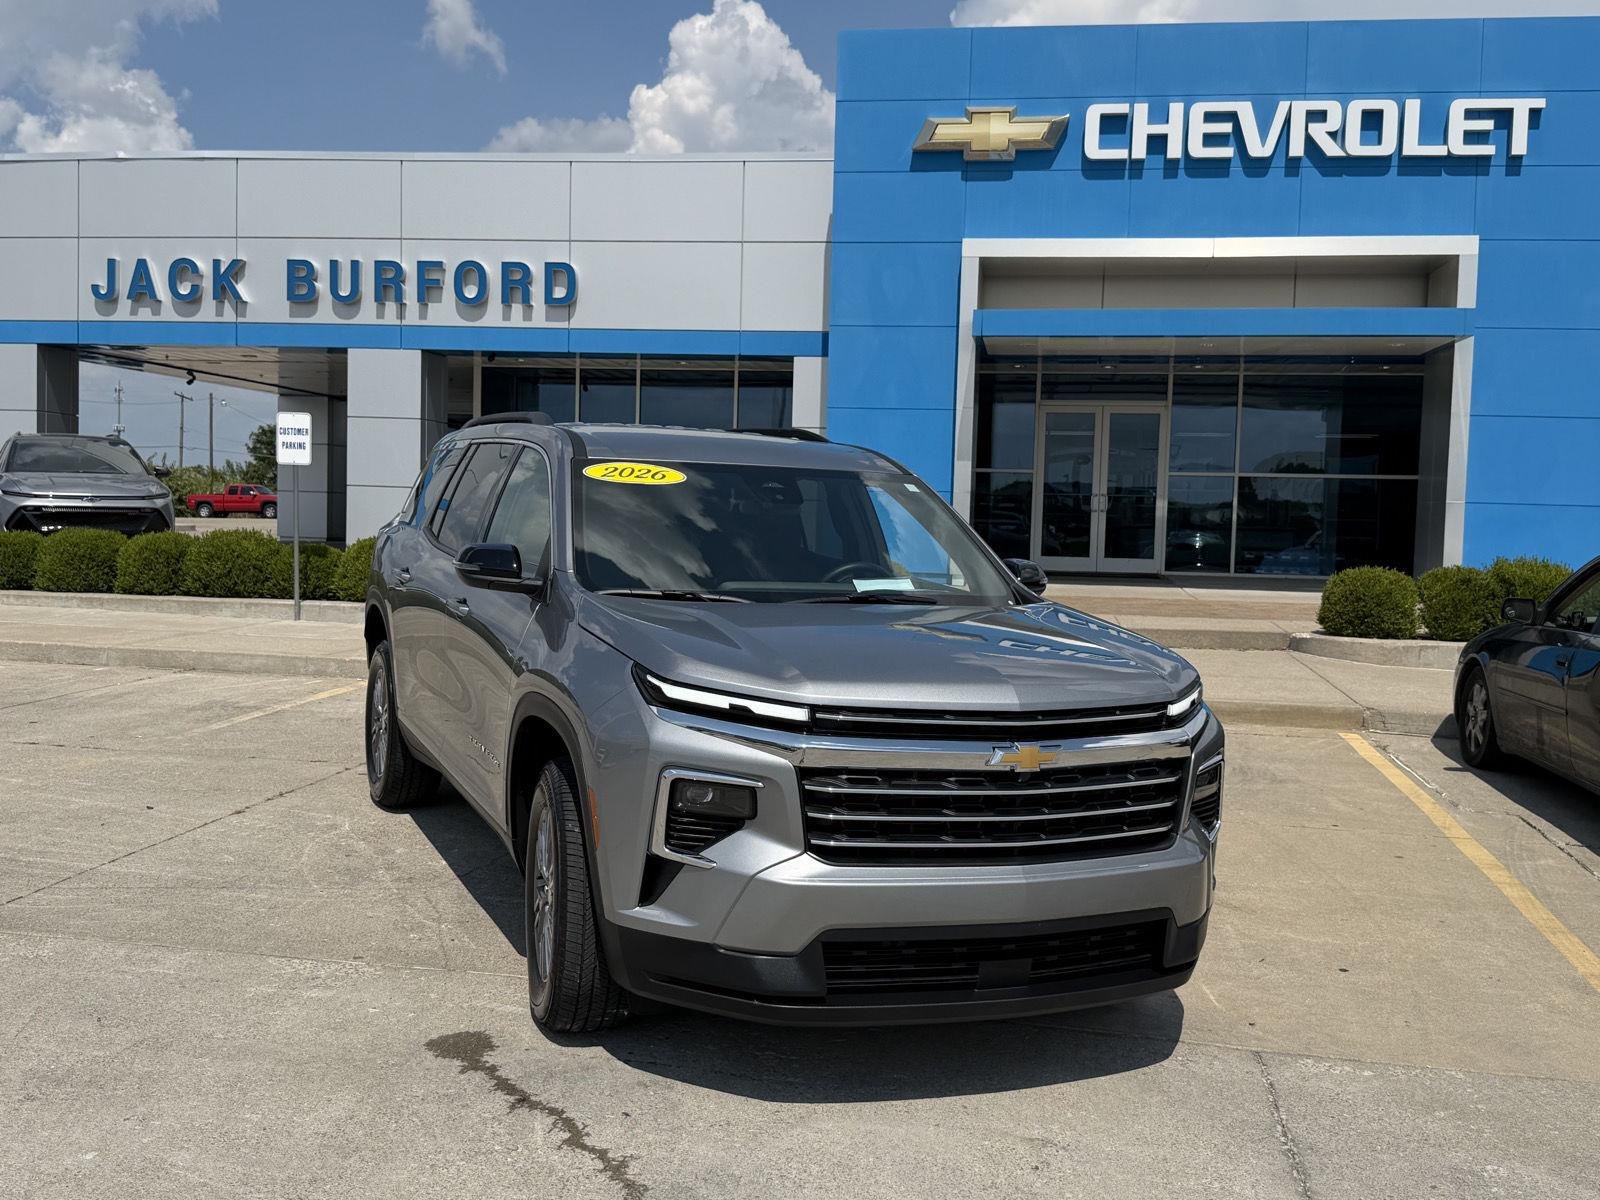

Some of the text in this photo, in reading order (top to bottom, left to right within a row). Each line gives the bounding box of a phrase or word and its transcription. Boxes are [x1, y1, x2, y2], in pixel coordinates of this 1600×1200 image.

[1084, 98, 1547, 160] CHEVROLET
[91, 257, 578, 306] JACK BURFORD
[279, 427, 309, 436] CUSTOMER
[281, 441, 306, 450] PARKING
[601, 466, 669, 481] 2026
